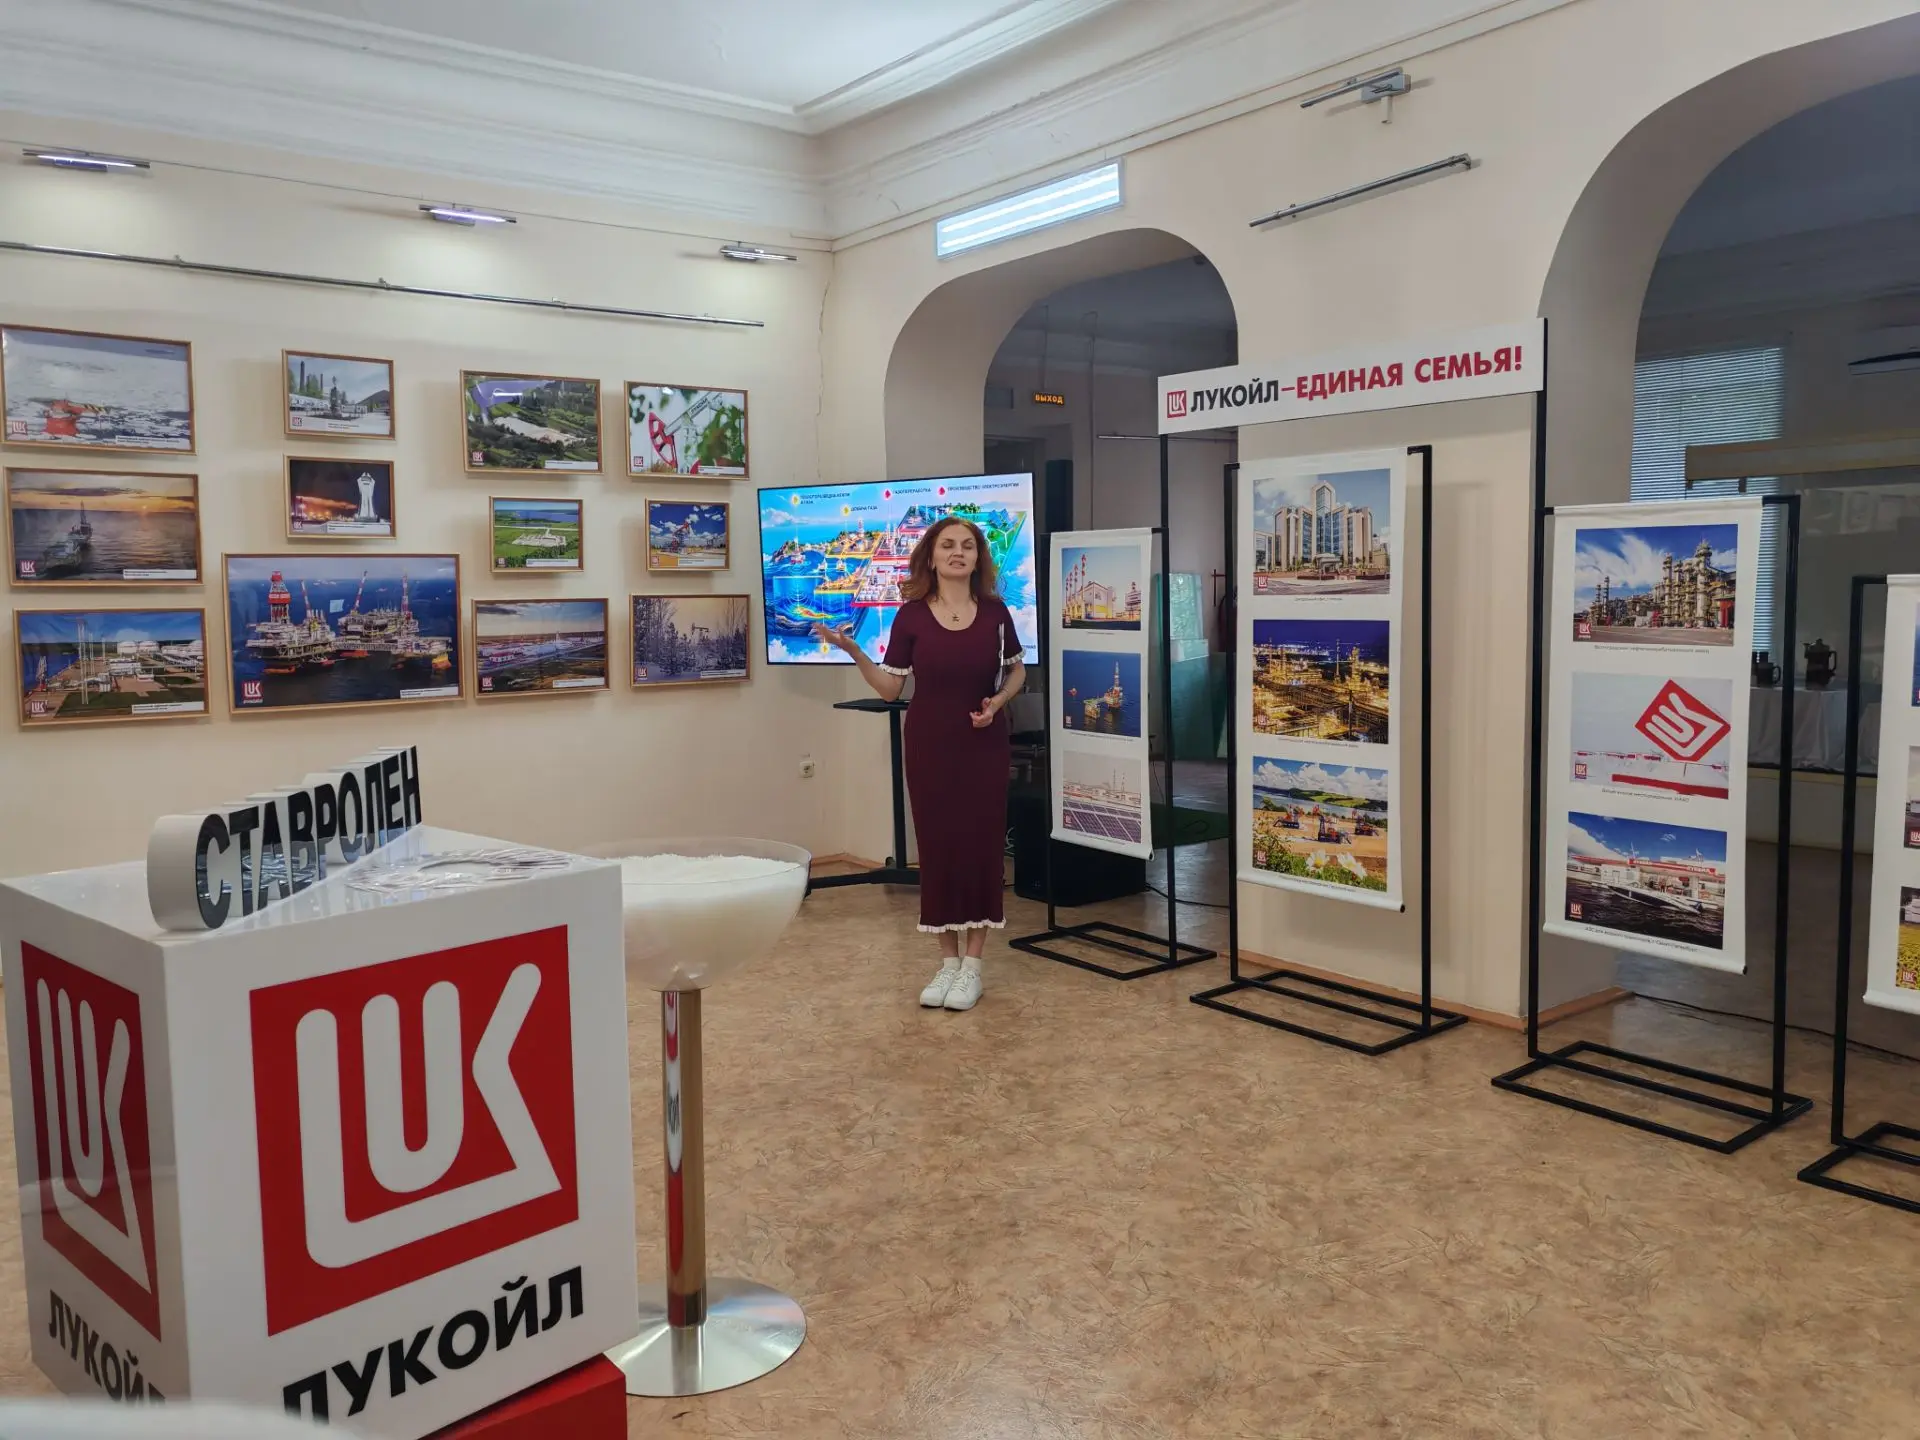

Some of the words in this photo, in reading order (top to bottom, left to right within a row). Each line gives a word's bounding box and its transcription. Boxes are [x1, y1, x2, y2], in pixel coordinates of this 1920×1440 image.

[1414, 345, 1523, 384] СЕМЬЯ!
[1034, 393, 1064, 405] ВЫХОД
[1168, 392, 1186, 416] LUK
[196, 745, 422, 930] СТАВРОЛЕН
[295, 962, 561, 1269] LUK
